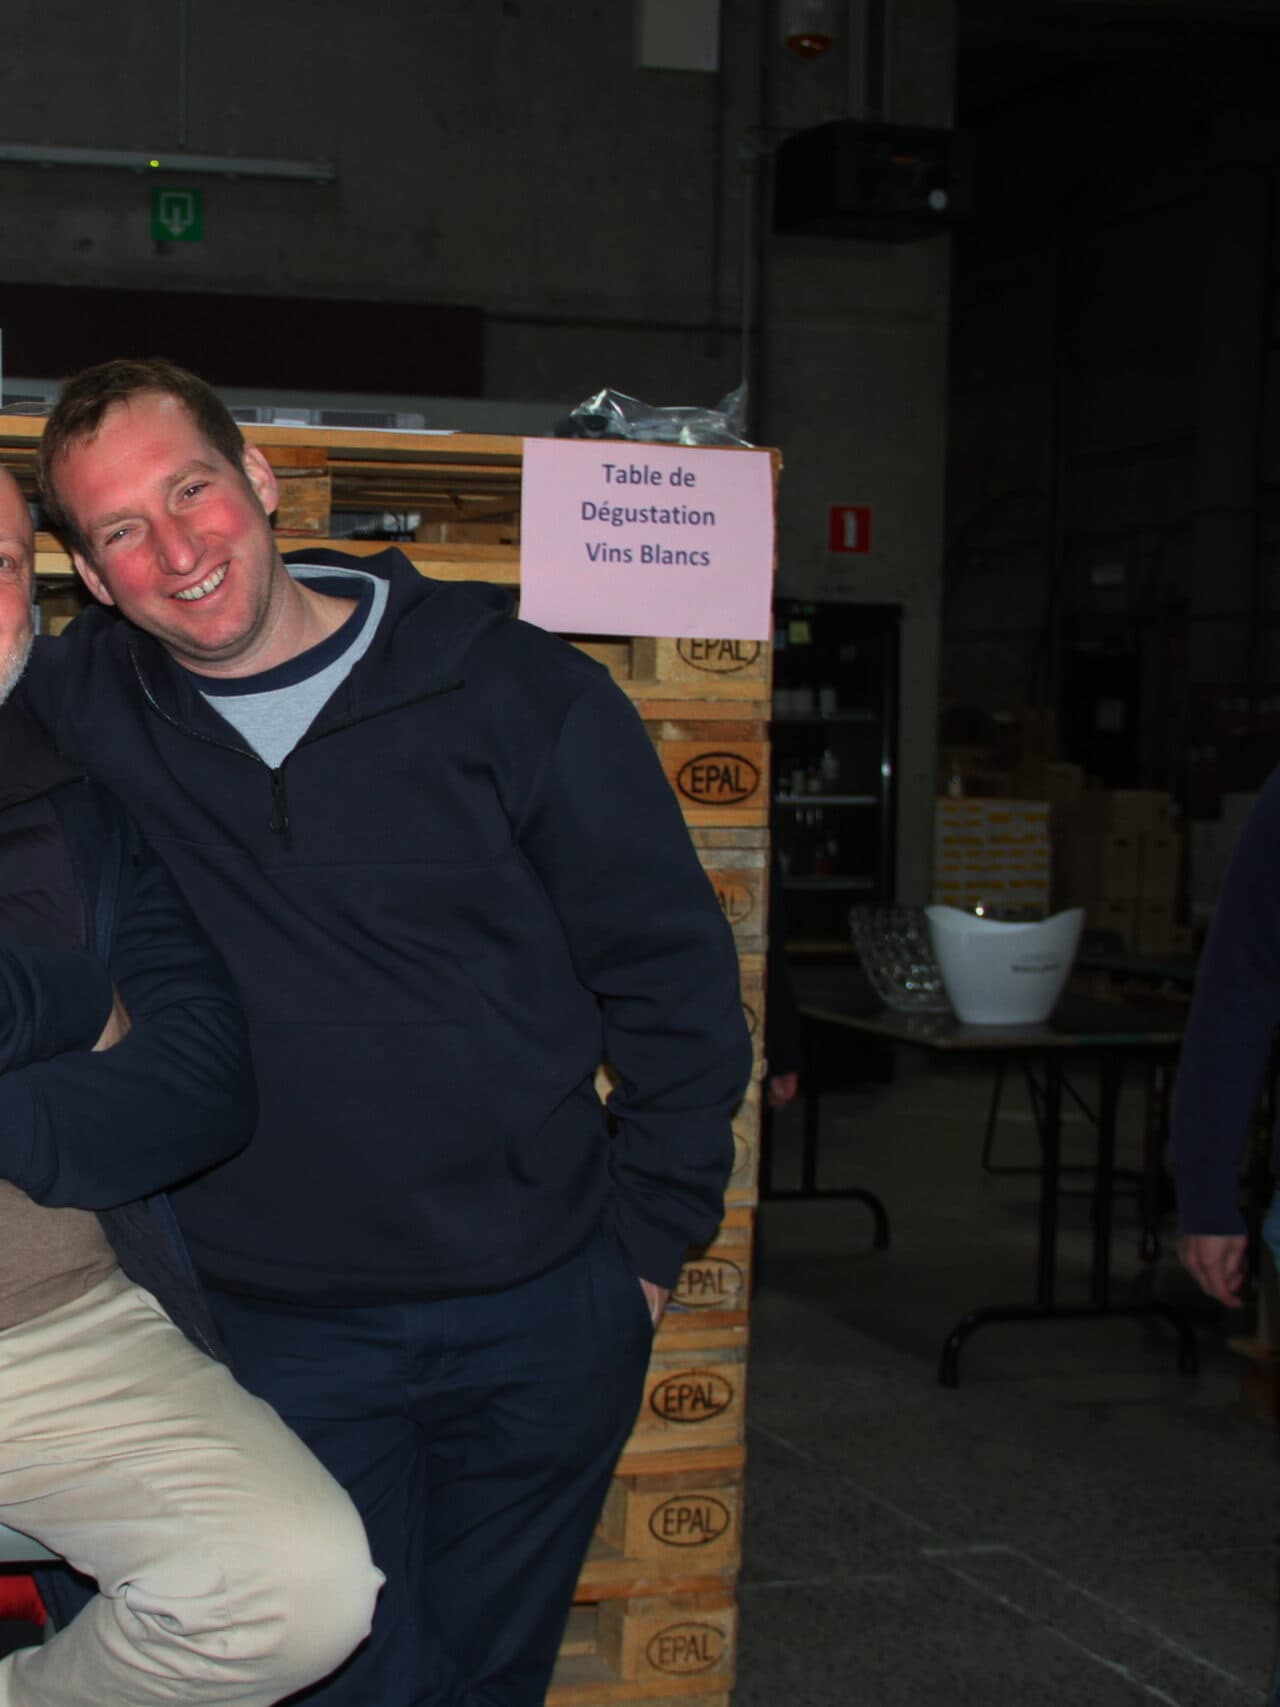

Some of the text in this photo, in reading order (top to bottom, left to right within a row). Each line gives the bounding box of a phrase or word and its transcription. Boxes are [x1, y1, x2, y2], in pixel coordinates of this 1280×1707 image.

[601, 463, 695, 487] Table de
[581, 501, 715, 527] Dégustation
[585, 542, 710, 567] Vins Blancs
[691, 765, 748, 793] EPAL
[664, 1382, 722, 1413] EPAL
[663, 1507, 720, 1536] EPAL
[657, 1632, 715, 1664] EPAL
